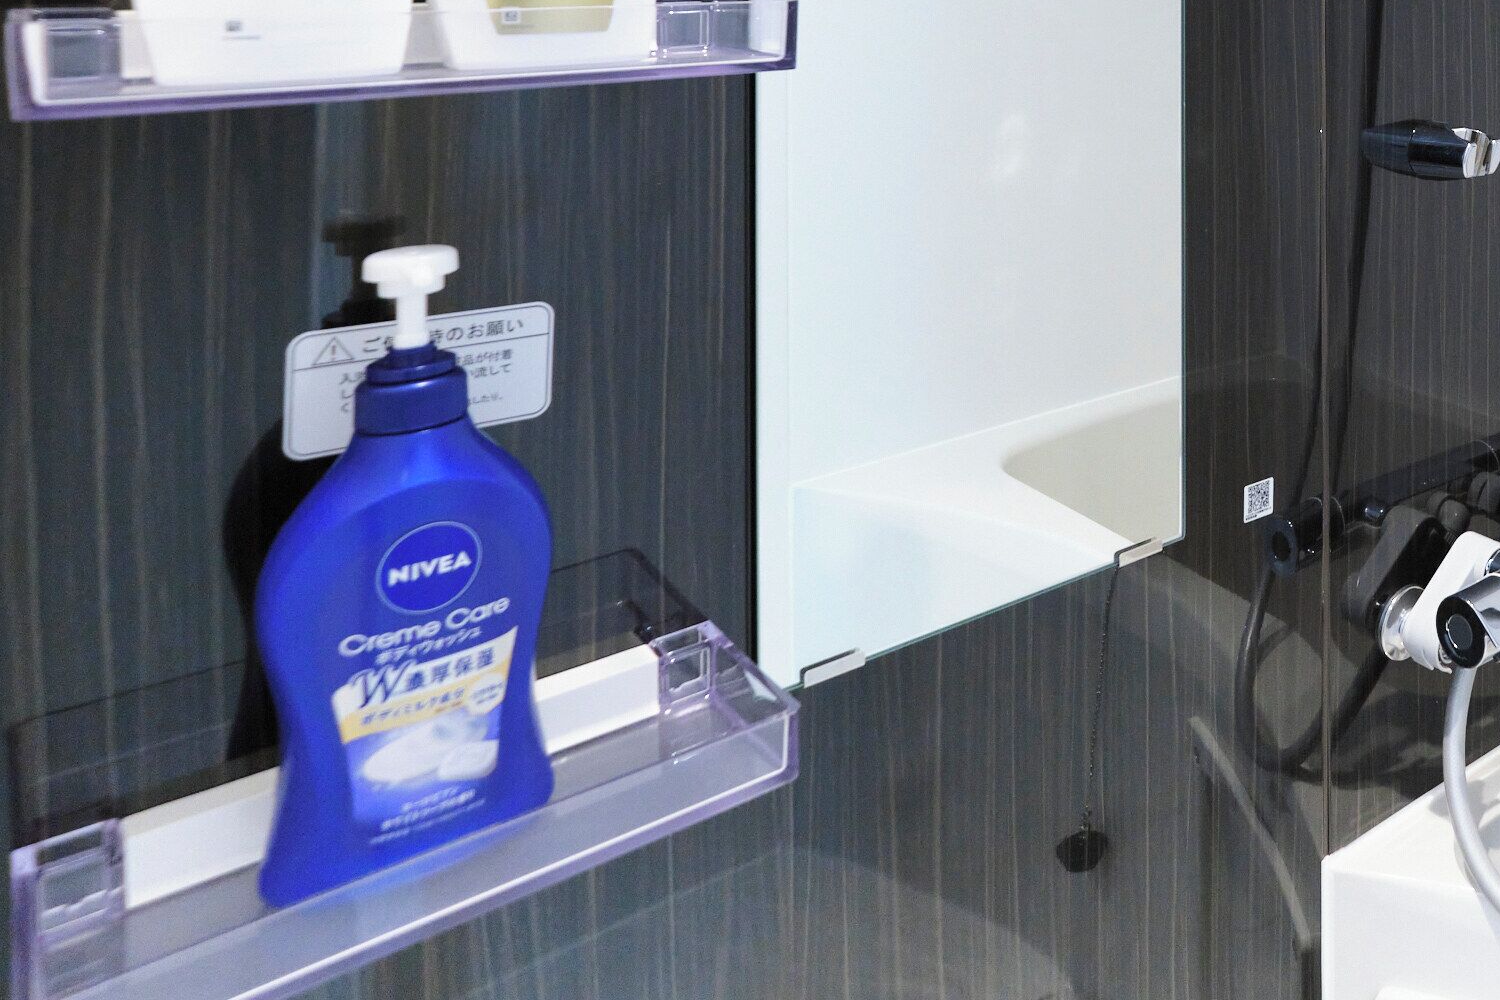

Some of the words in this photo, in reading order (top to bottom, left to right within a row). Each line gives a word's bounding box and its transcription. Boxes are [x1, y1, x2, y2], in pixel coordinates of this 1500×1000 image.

[386, 550, 472, 588] NIVEA
[338, 620, 442, 657] Creme
[444, 597, 511, 630] Care
